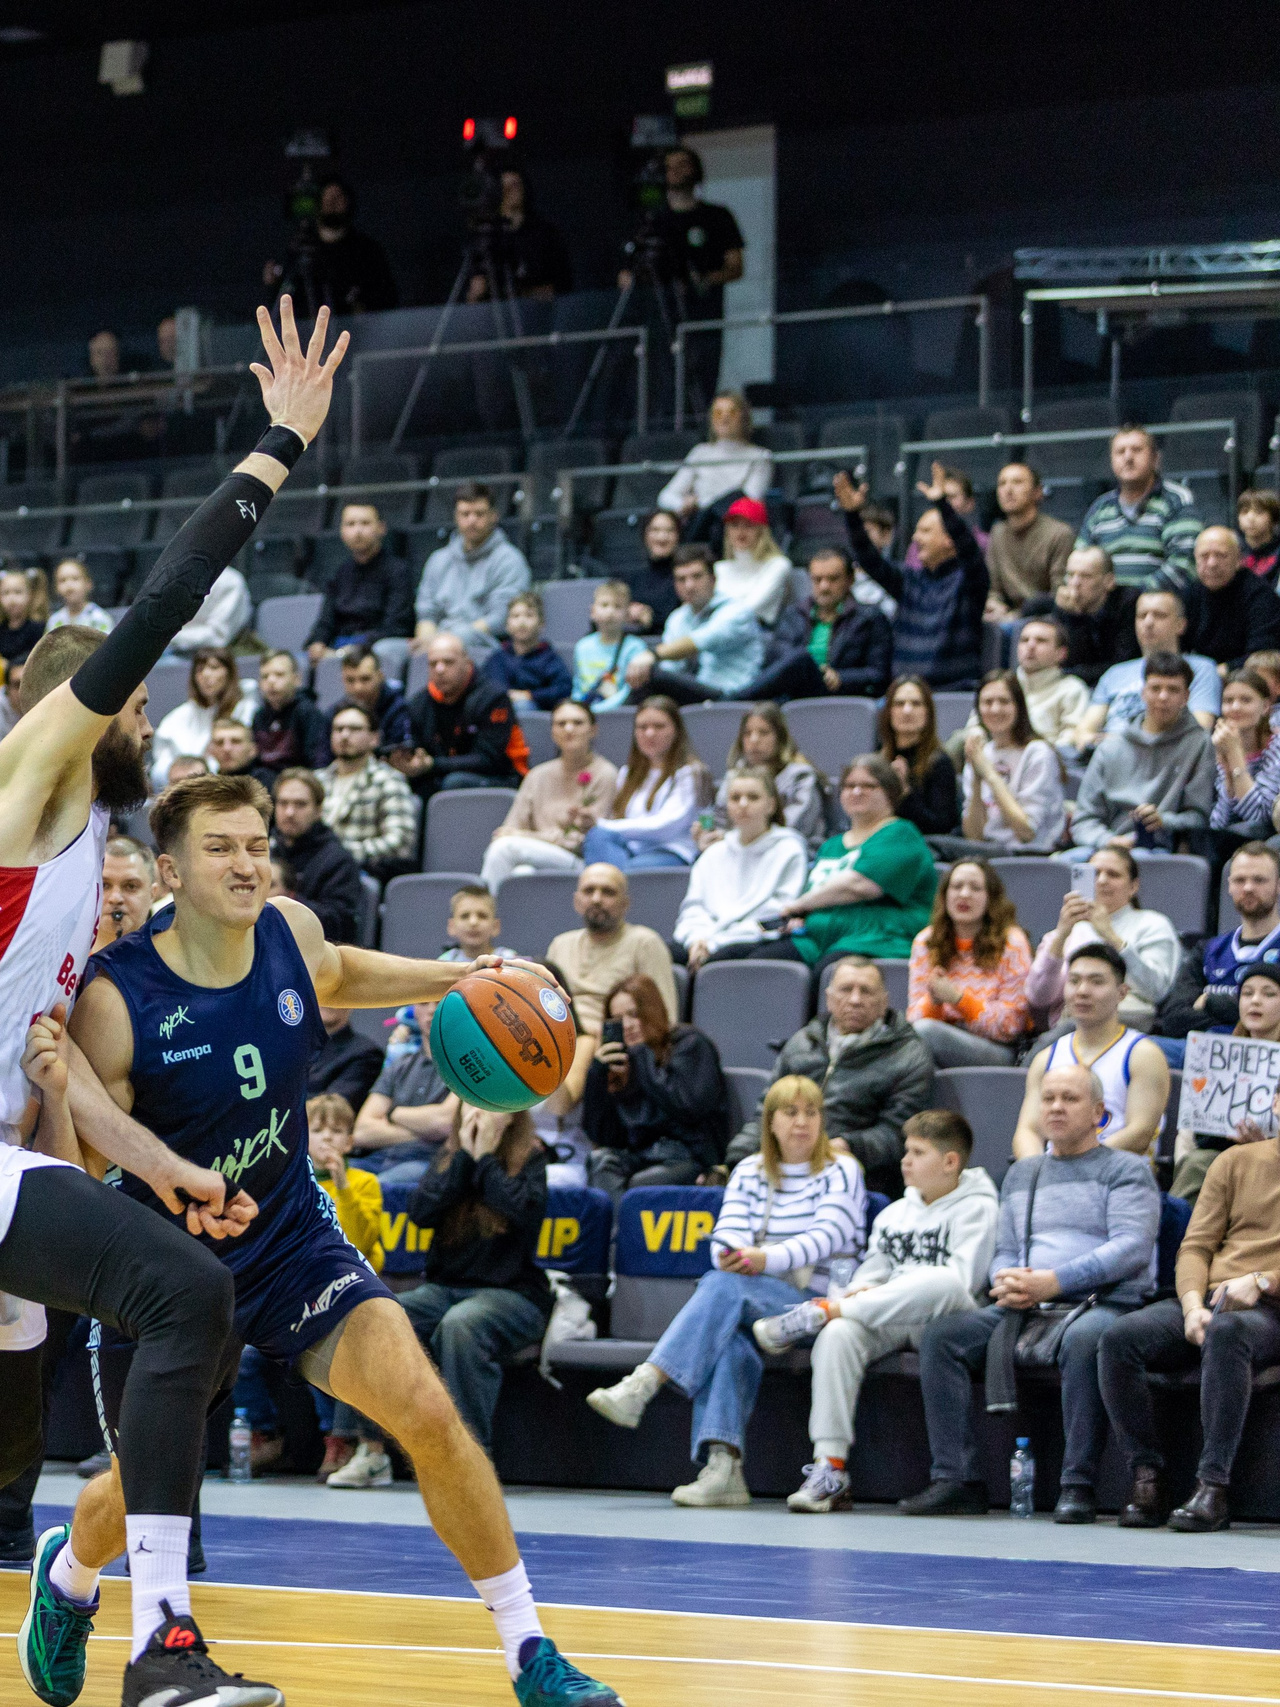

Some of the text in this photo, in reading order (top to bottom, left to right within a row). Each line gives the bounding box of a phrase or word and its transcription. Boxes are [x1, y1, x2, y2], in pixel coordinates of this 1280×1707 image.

[162, 1043, 213, 1065] Kempa
[232, 1043, 267, 1100] 9
[458, 1053, 486, 1084] FIBA
[469, 1048, 492, 1077] APPROVED
[536, 1217, 581, 1259] IP
[639, 1209, 716, 1253] VIP
